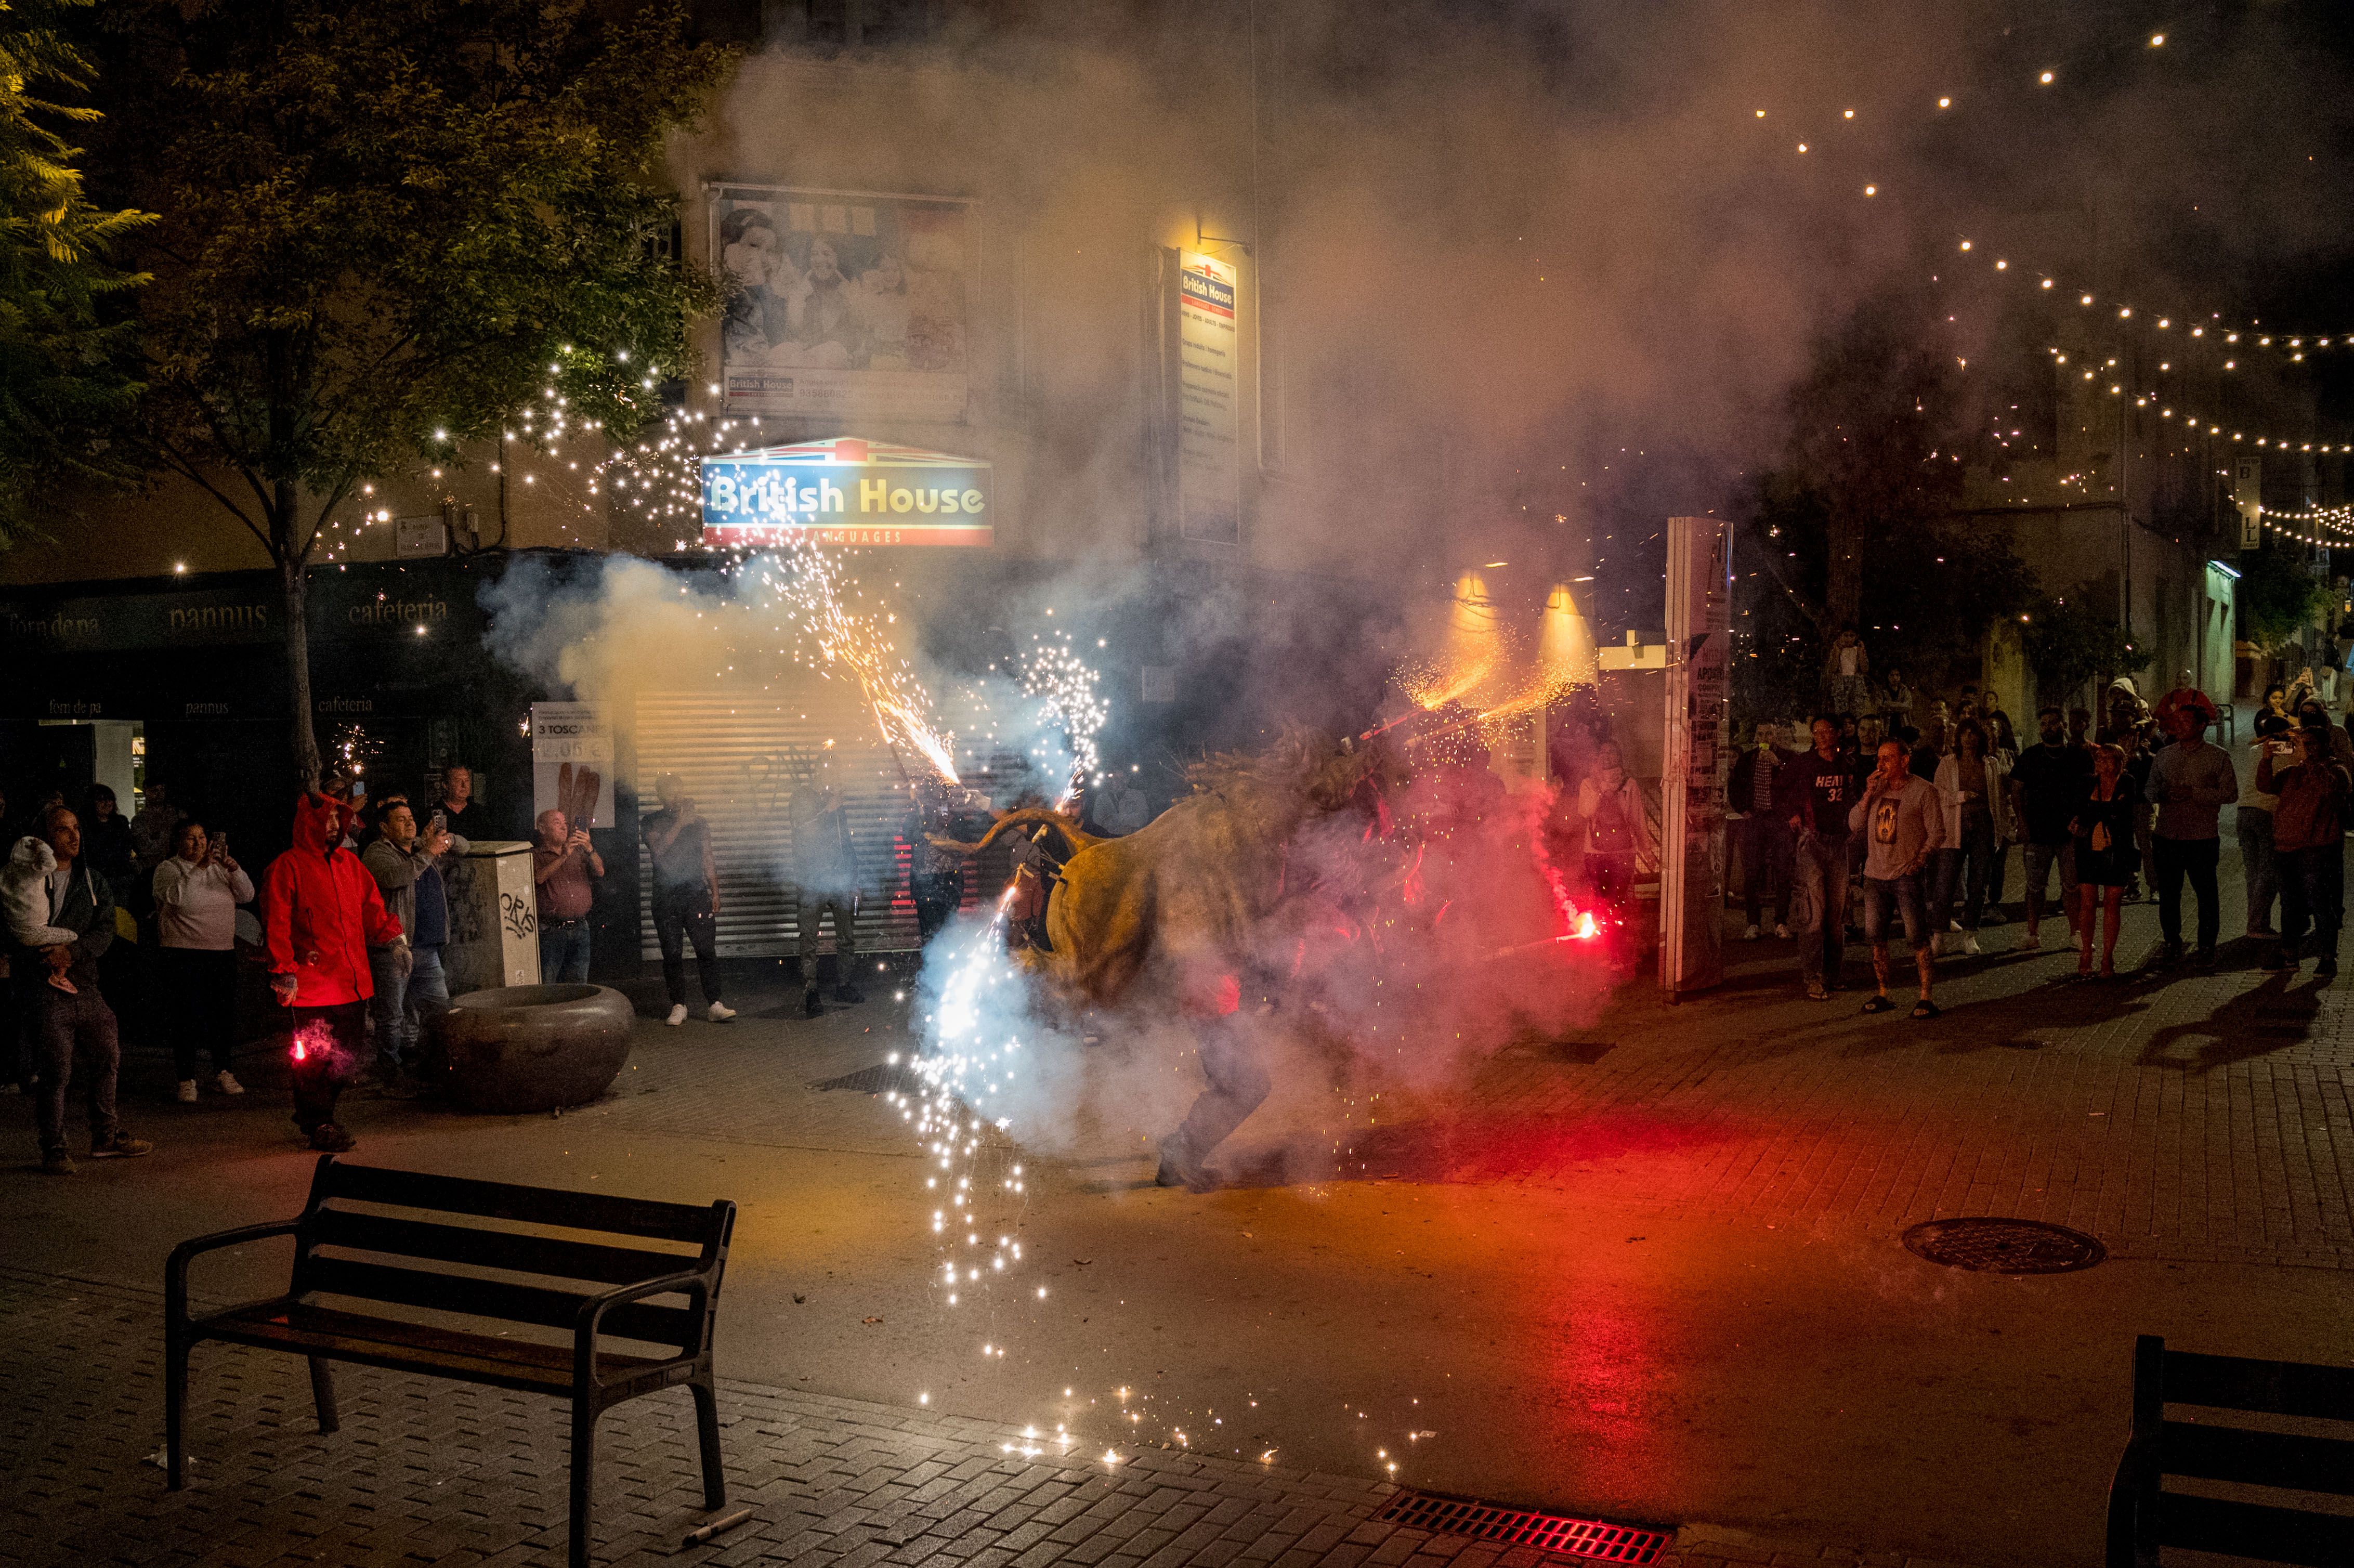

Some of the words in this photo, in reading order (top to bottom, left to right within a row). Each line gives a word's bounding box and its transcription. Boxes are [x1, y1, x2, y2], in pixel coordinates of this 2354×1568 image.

[1183, 275, 1207, 296] British
[1209, 284, 1232, 305] House
[730, 379, 760, 388] British
[763, 380, 792, 389] House
[711, 475, 844, 513] British
[860, 478, 986, 514] House
[803, 530, 901, 543] LANGUAGES
[349, 593, 447, 624] cafeteria
[49, 698, 70, 714] forn
[73, 698, 86, 714] de
[89, 702, 101, 717] pa
[186, 702, 229, 718] pannus
[318, 695, 373, 713] cafeteria
[539, 725, 546, 734] 3
[1827, 788, 1843, 802] 32
